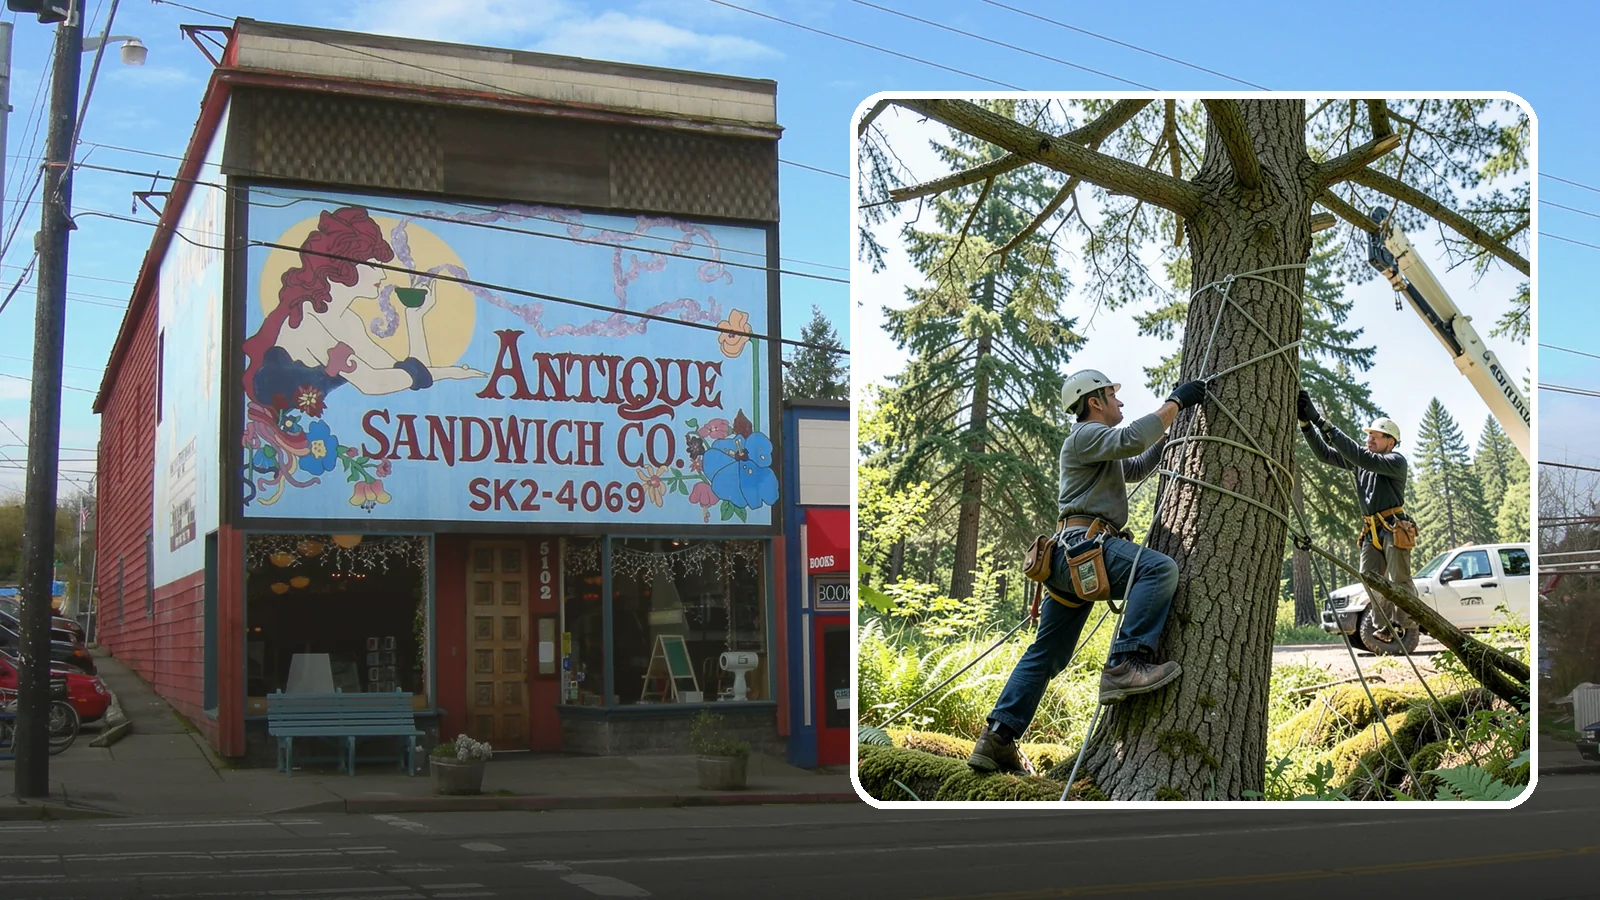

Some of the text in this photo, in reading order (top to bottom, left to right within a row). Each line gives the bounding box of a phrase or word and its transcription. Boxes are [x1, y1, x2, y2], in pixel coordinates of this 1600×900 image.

[476, 329, 723, 421] ANTIQUE
[361, 408, 684, 469] SANDWICH CO.
[468, 477, 645, 513] SK2-4069
[539, 541, 552, 600] 5102
[809, 555, 835, 569] BOOKS
